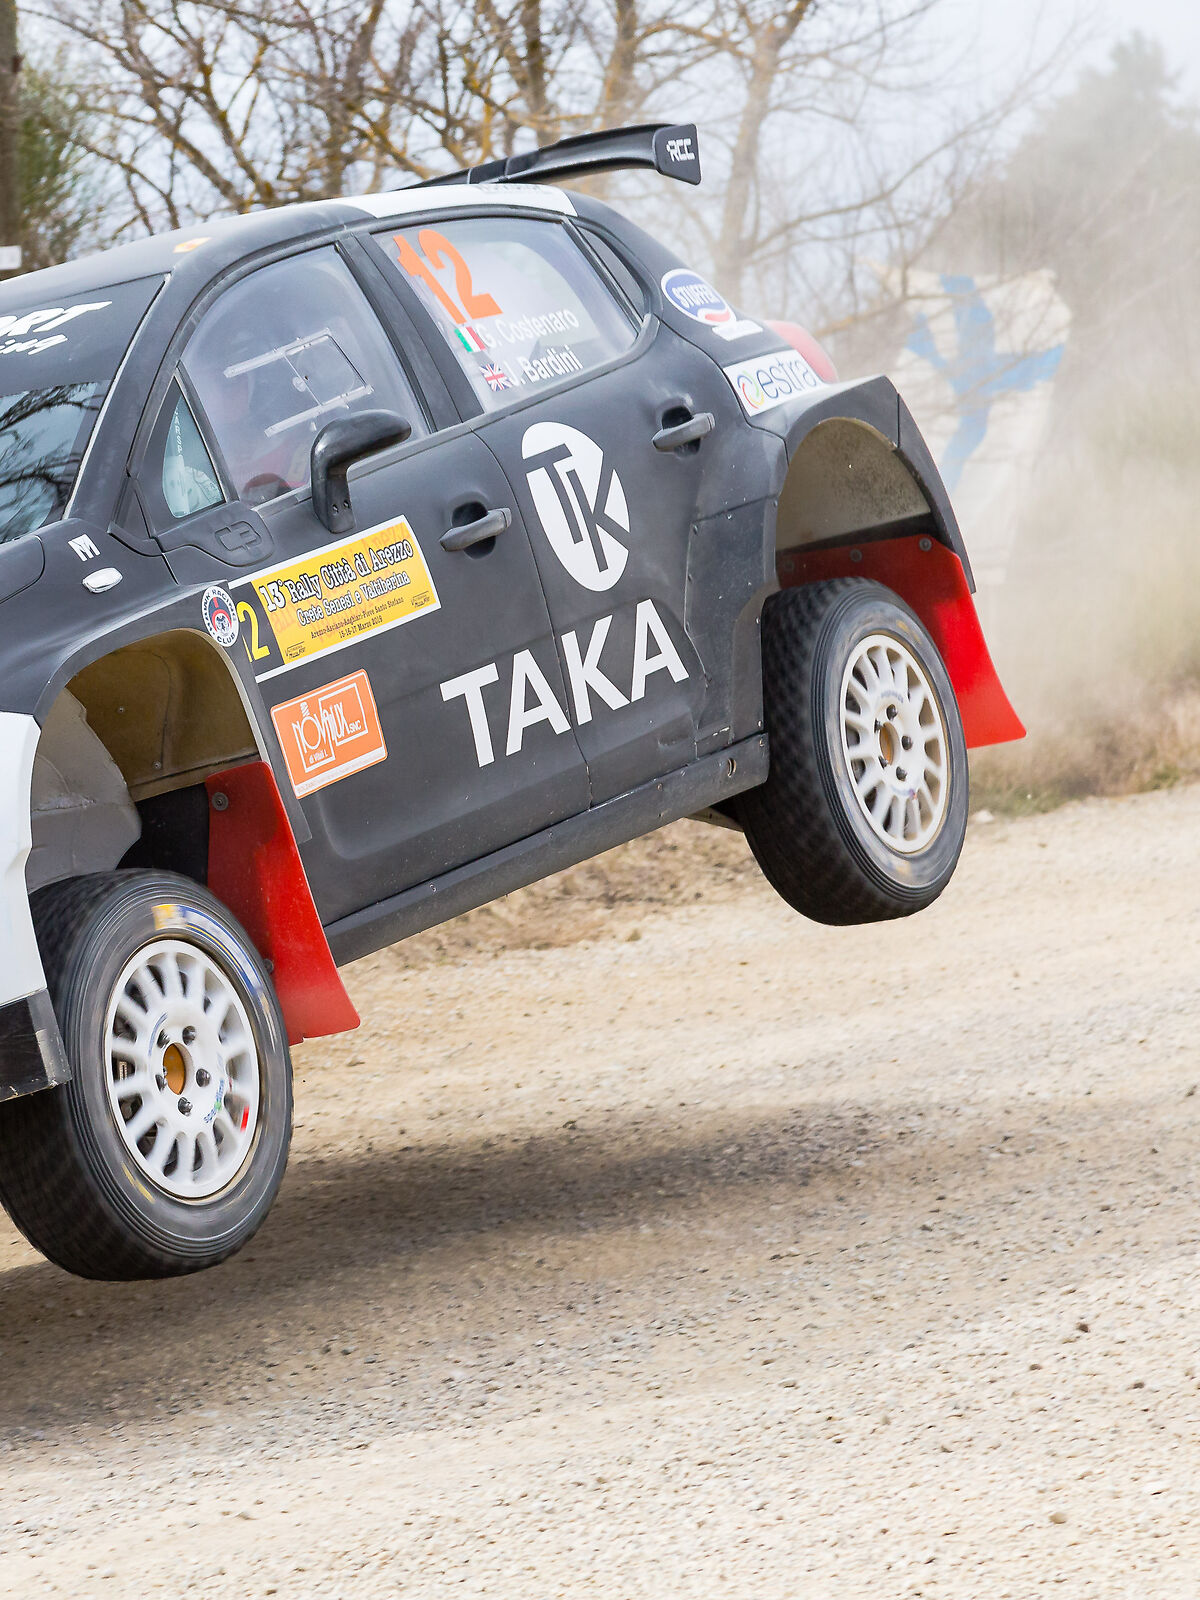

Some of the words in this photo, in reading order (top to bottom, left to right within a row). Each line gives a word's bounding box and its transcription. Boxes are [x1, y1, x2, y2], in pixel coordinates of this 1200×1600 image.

[393, 228, 503, 324] 12
[494, 308, 580, 344] Costenaro
[516, 344, 583, 383] Bardini
[756, 358, 818, 399] estra
[284, 573, 322, 603] Rally
[320, 558, 357, 589] Città
[354, 553, 372, 578] di
[368, 539, 414, 572] Arezzo
[296, 604, 324, 626] Crete
[322, 590, 355, 616] Senesi
[354, 590, 362, 604] e
[359, 570, 412, 600] Valtiberina
[216, 632, 236, 645] CLUB
[236, 602, 271, 662] 2
[440, 599, 689, 768] TAKA
